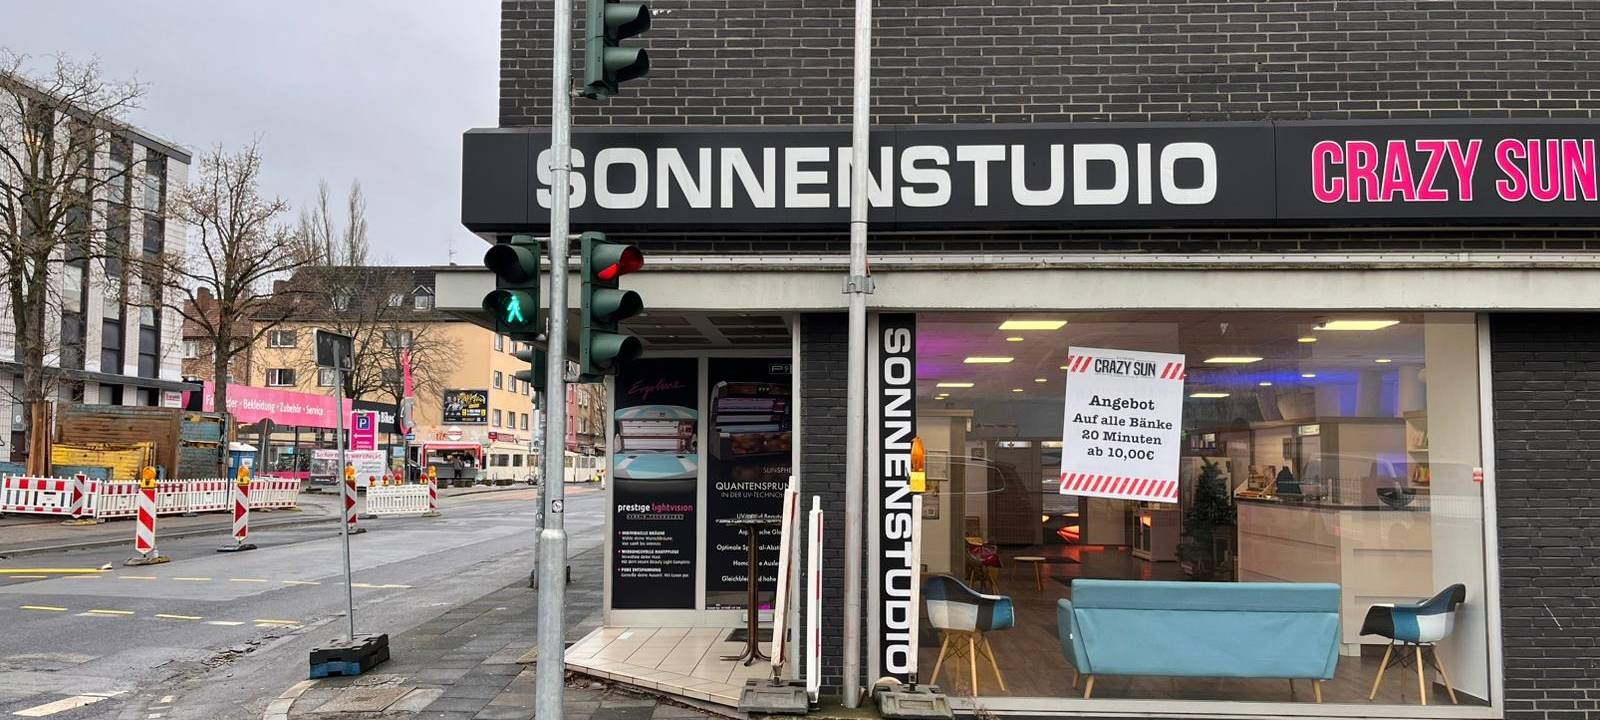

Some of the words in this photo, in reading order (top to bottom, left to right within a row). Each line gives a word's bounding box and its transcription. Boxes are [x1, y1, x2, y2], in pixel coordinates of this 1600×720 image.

[536, 142, 1218, 209] SONNENSTUDIO
[1311, 139, 1483, 204] CRAZY
[1495, 138, 1598, 202] SUN
[1094, 358, 1132, 375] CRAZY
[1133, 361, 1156, 377] SUN
[243, 399, 275, 414] Bekleidung
[279, 401, 302, 413] Zubehör
[306, 405, 324, 416] Service
[1088, 395, 1155, 411] Angebot
[359, 418, 367, 428] P
[1072, 413, 1099, 425] Auf
[1100, 415, 1126, 427] alle
[1129, 417, 1173, 430] Bänke
[1082, 429, 1099, 440] 20
[1102, 431, 1162, 446] Minuten
[1087, 446, 1103, 456] ab
[1108, 447, 1155, 462] 10,00€
[617, 504, 651, 513] prestige
[651, 503, 694, 513] lightvision
[883, 326, 912, 675] SONNENSTUDIO
[716, 544, 742, 552] Optimale
